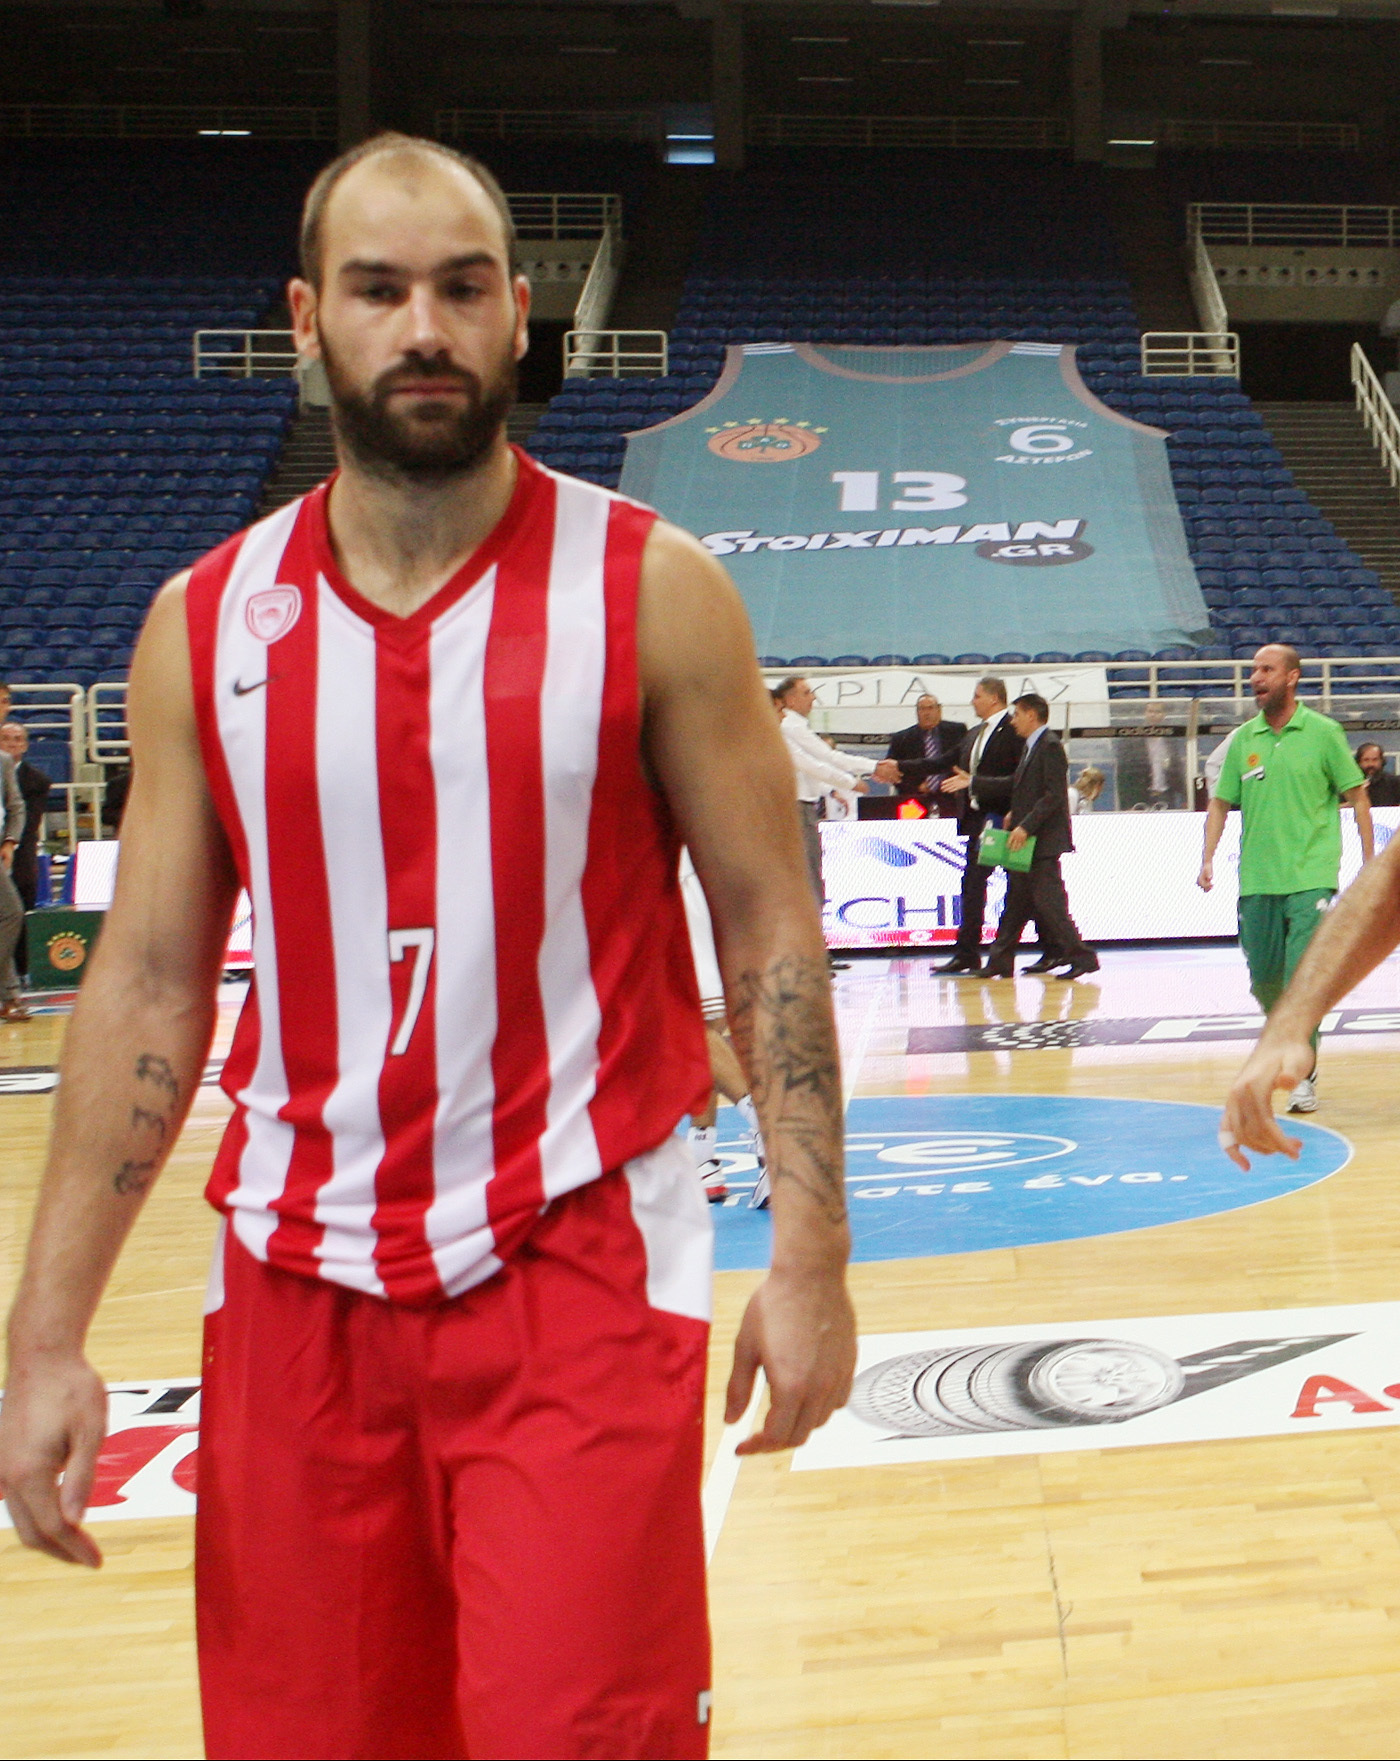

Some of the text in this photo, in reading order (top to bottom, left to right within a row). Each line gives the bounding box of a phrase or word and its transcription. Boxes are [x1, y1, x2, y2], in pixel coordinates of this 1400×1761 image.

[1009, 424, 1074, 454] 6
[831, 470, 968, 512] 13
[387, 928, 436, 1056] 7
